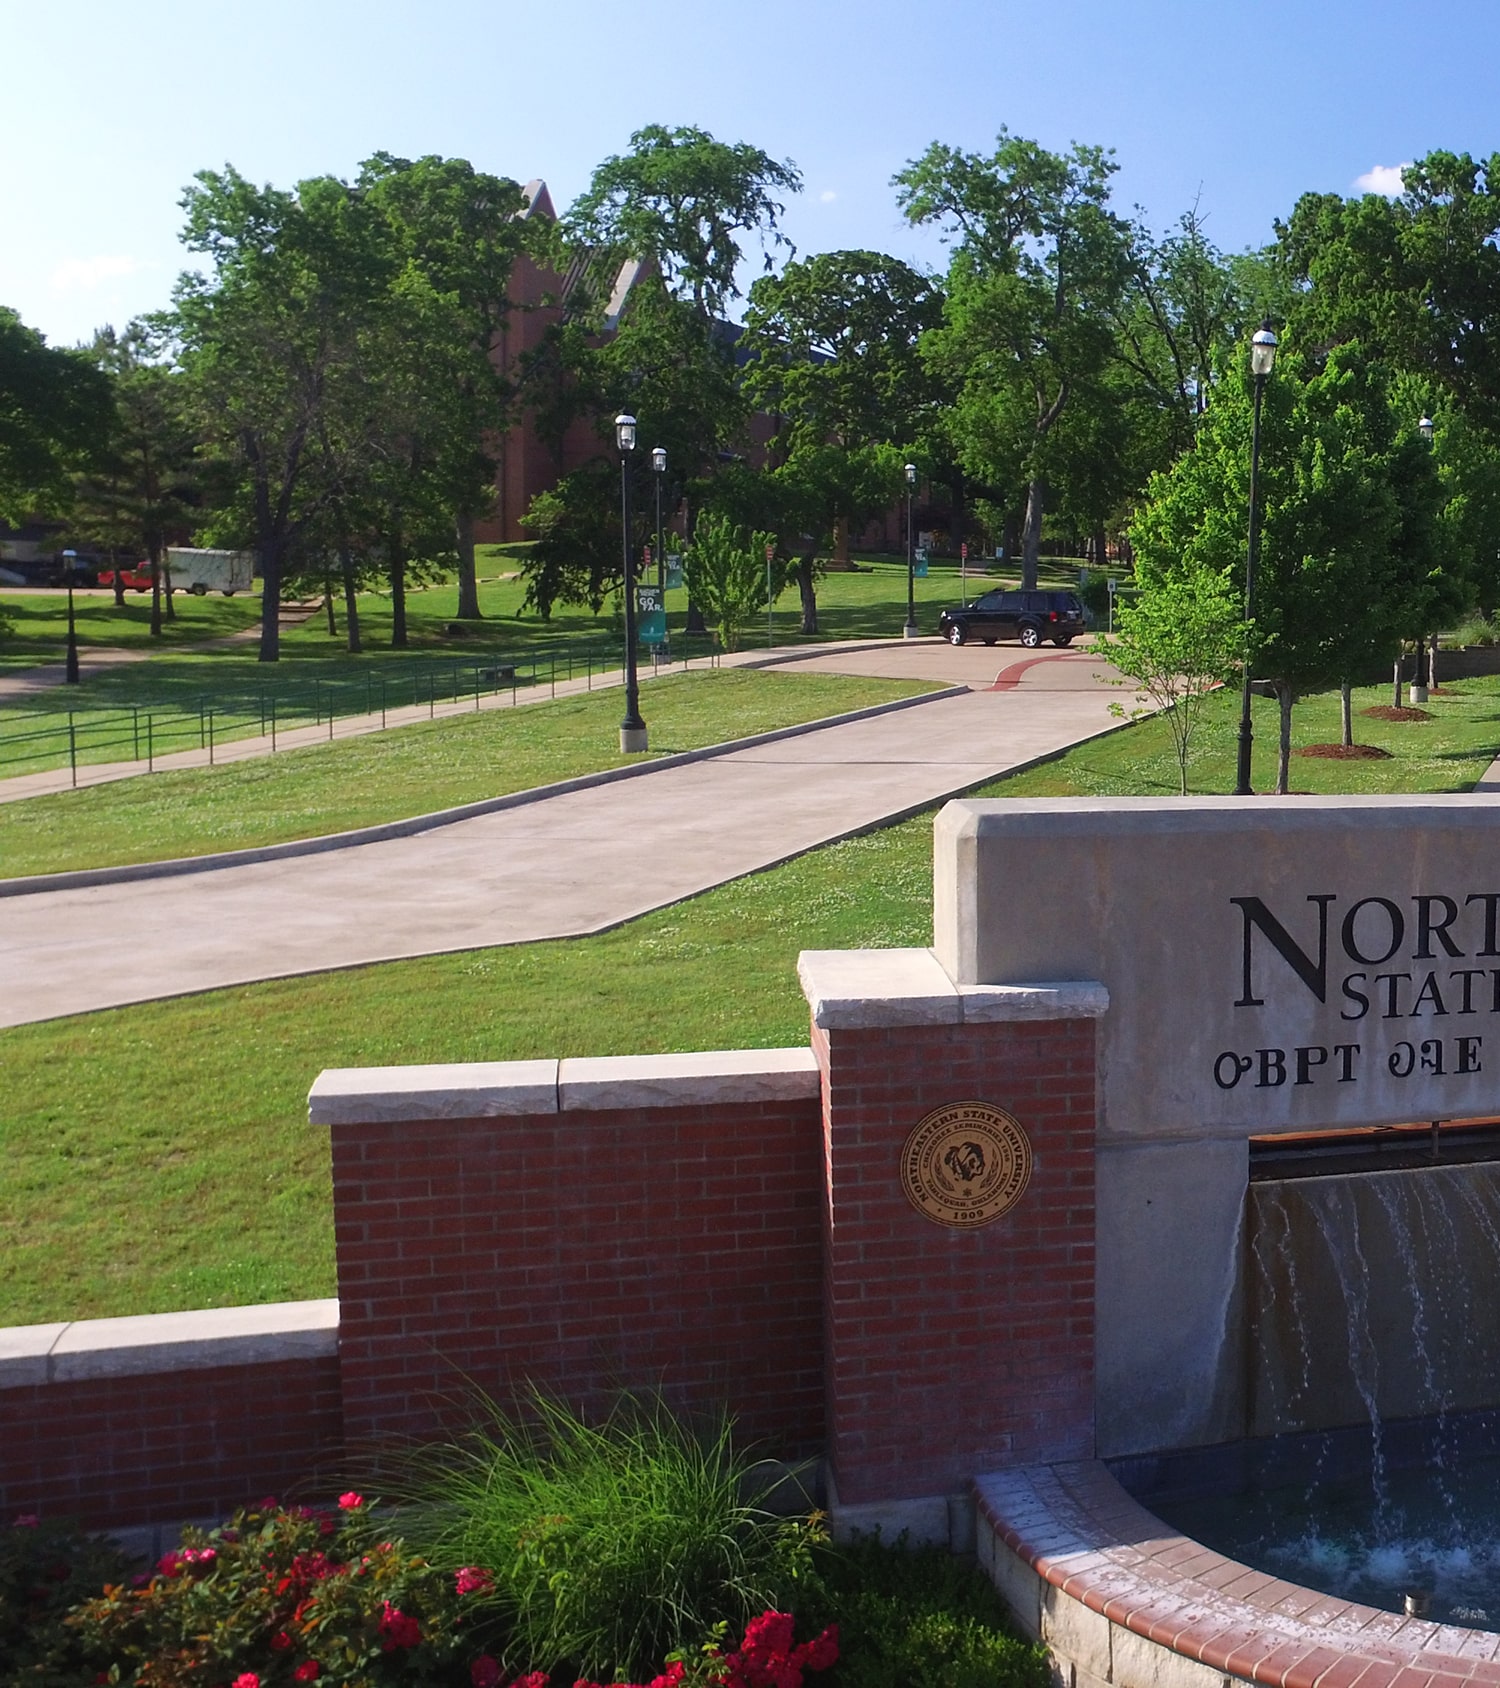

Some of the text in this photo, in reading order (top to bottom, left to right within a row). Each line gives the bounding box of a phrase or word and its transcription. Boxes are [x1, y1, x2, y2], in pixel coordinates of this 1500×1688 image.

[639, 597, 655, 605] GO
[909, 1110, 1024, 1203] NORTHEASTERN STATE UNIVERSITY
[923, 1127, 952, 1169] CHEROKEE
[953, 1122, 1003, 1144] SEMINARIES
[971, 1172, 1009, 1206] OKLAHOMA
[953, 1209, 984, 1220] 1909
